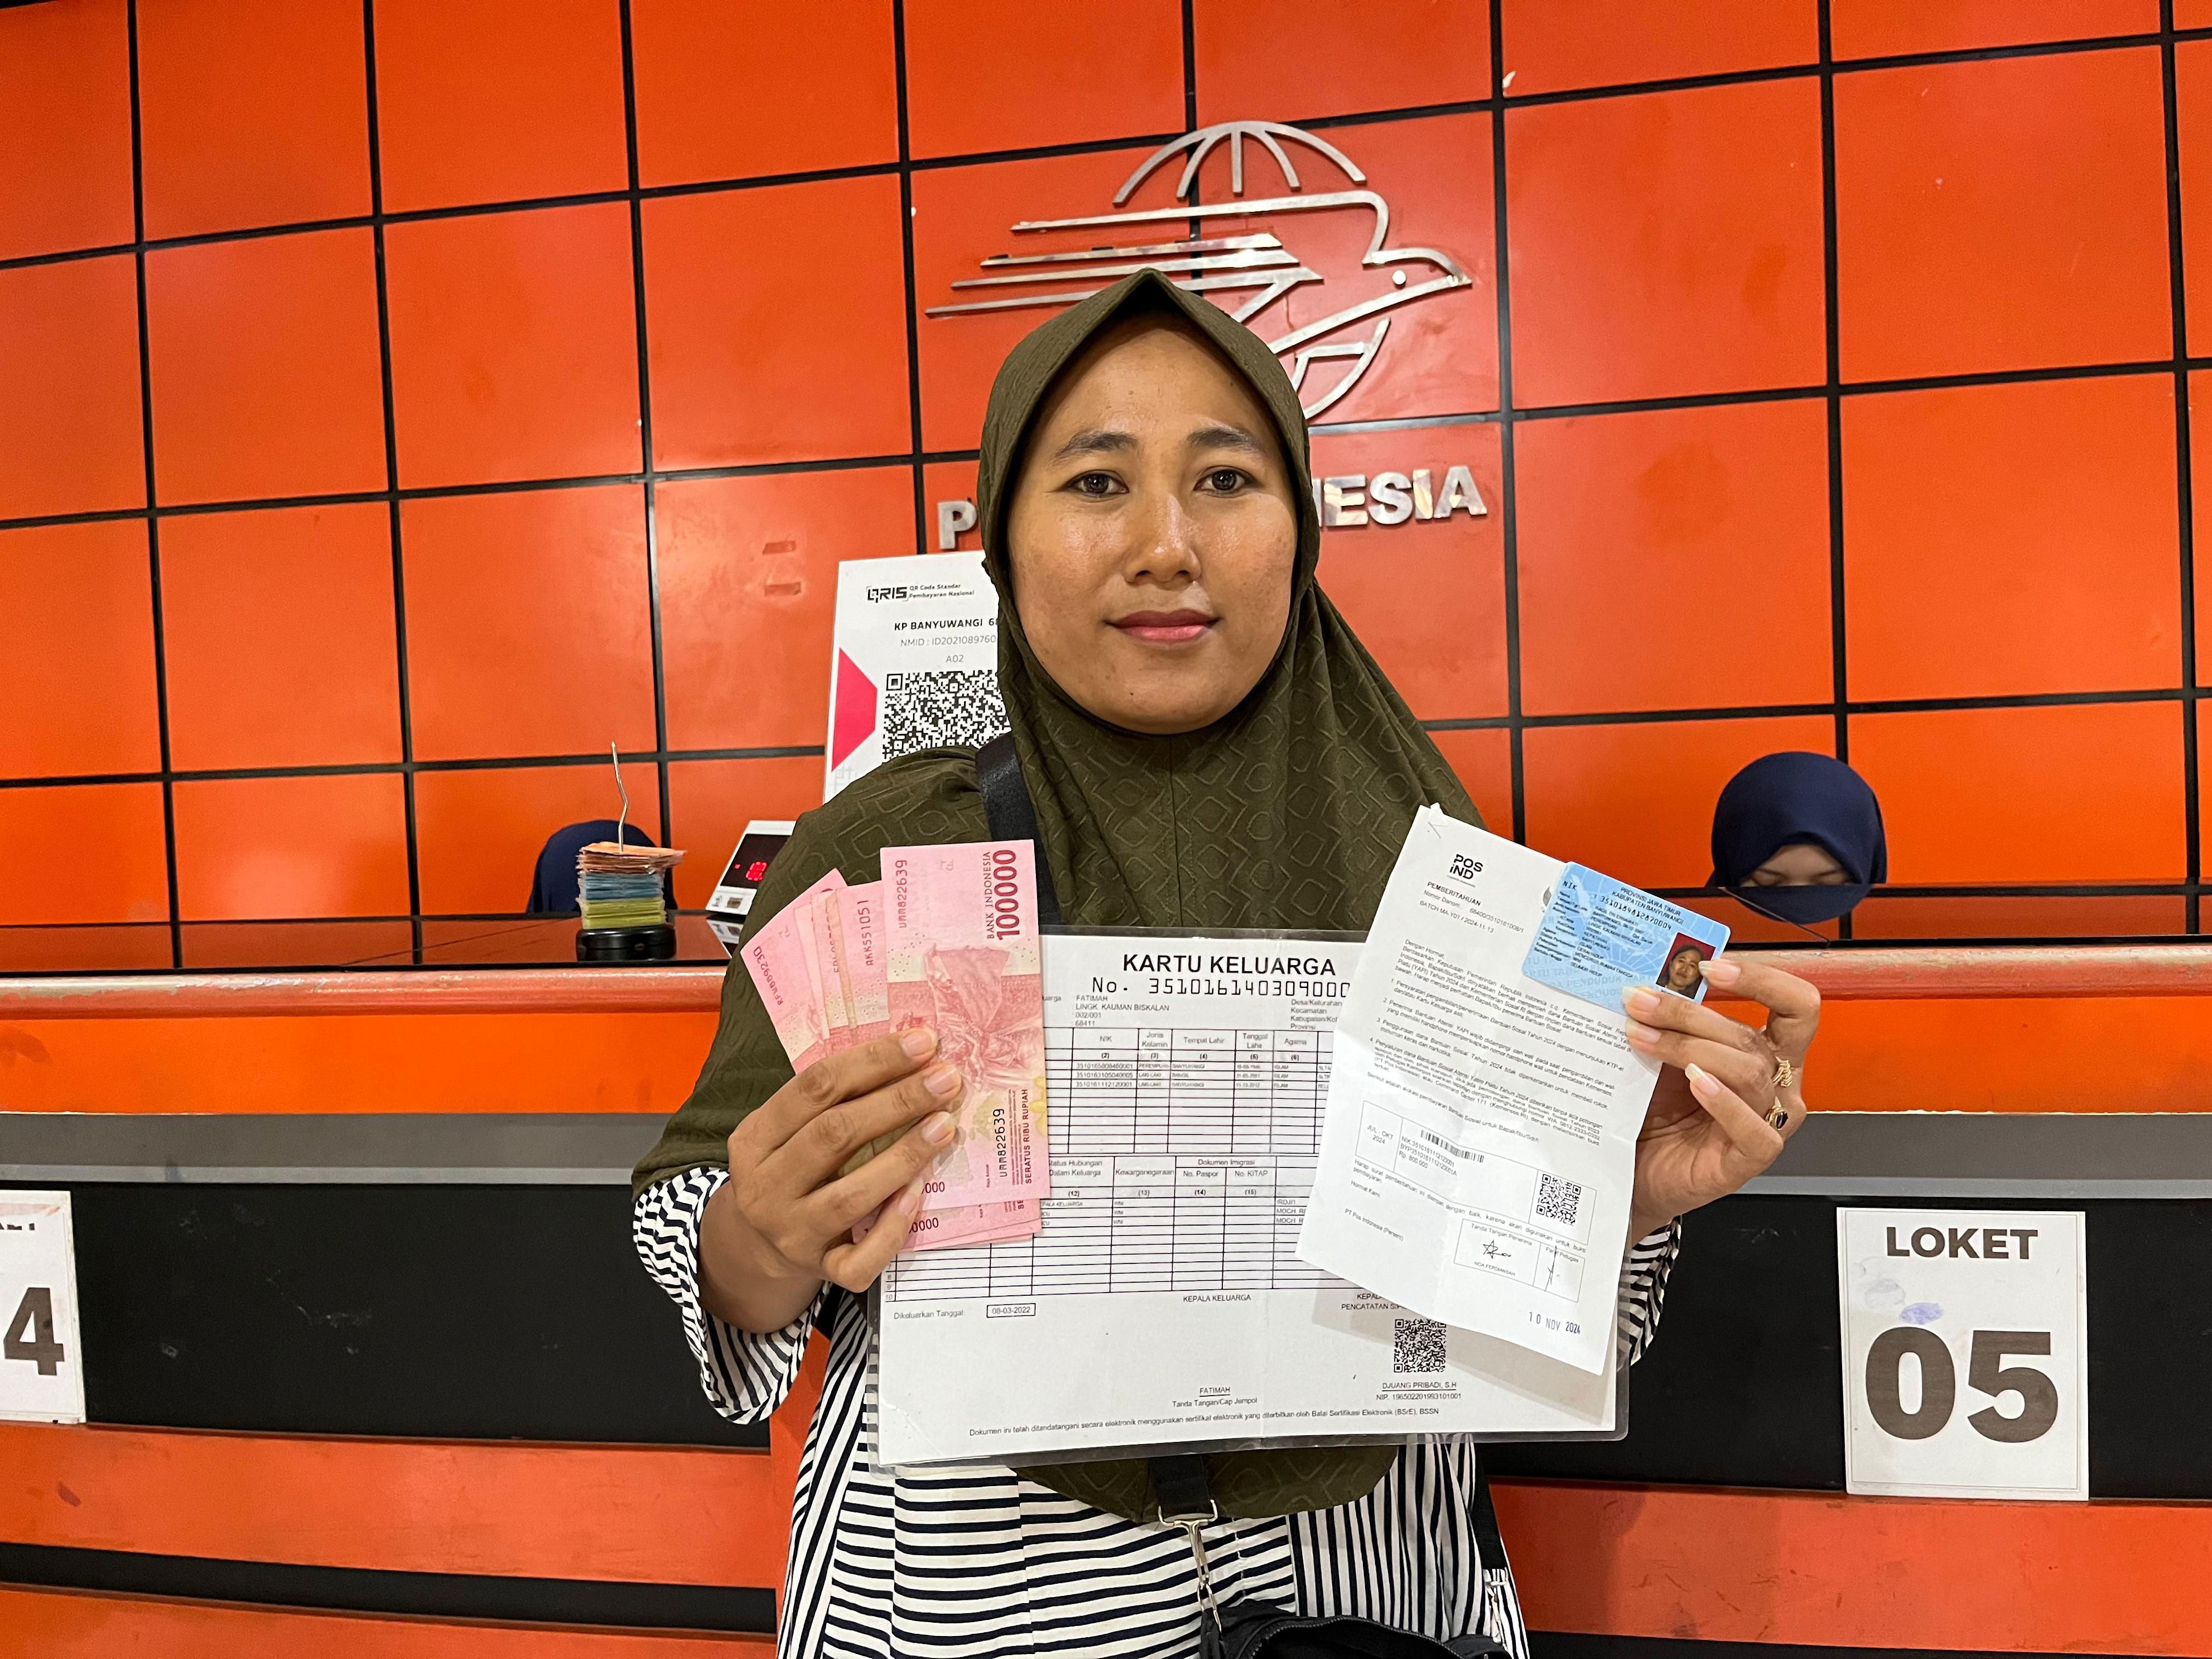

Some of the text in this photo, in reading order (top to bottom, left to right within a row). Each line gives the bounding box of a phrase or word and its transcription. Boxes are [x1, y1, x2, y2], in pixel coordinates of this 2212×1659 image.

[910, 619, 982, 630] BANYUWANGI
[901, 635, 996, 647] NMID ID2021089760
[1453, 853, 1483, 872] POS
[983, 851, 993, 908] INDONESIA
[1563, 880, 1577, 890] NIK
[992, 850, 1020, 940] 100000
[1427, 881, 1481, 906] PEMBERITAHUAN
[1620, 887, 1680, 916] PROVINSI JAWA TIMUR
[1419, 900, 1439, 911] BATCH
[1612, 891, 1646, 908] KABUPATEN
[1646, 905, 1683, 924] BANYUWANGI
[1405, 939, 1425, 950] Dengan
[1123, 953, 1336, 976] KARTU KELUARGA
[1092, 977, 1129, 993] No.
[1445, 977, 1458, 986] 2024
[1367, 1125, 1393, 1139] JUL OKT
[1372, 1134, 1385, 1144] 2024
[993, 1108, 1008, 1177] UMM822639
[1023, 1145, 1032, 1184] SERATUS
[1068, 1159, 1102, 1168] Hubungan
[922, 1181, 945, 1194] 000
[1352, 1212, 1361, 1220] Pos
[1472, 1223, 1487, 1232] Tanda
[1489, 1228, 1507, 1237] Tangan
[1887, 1227, 2038, 1260] LOKET
[1545, 1318, 1560, 1330] NOV
[1565, 1322, 1580, 1334] 2024
[1866, 1326, 2059, 1443] 05
[970, 1428, 1001, 1436] Dokumen
[1032, 1422, 1080, 1432] ditandatangani
[1105, 1419, 1136, 1427] elektronik
[1138, 1417, 1183, 1426] menggunakan
[1213, 1412, 1243, 1421] elektronik
